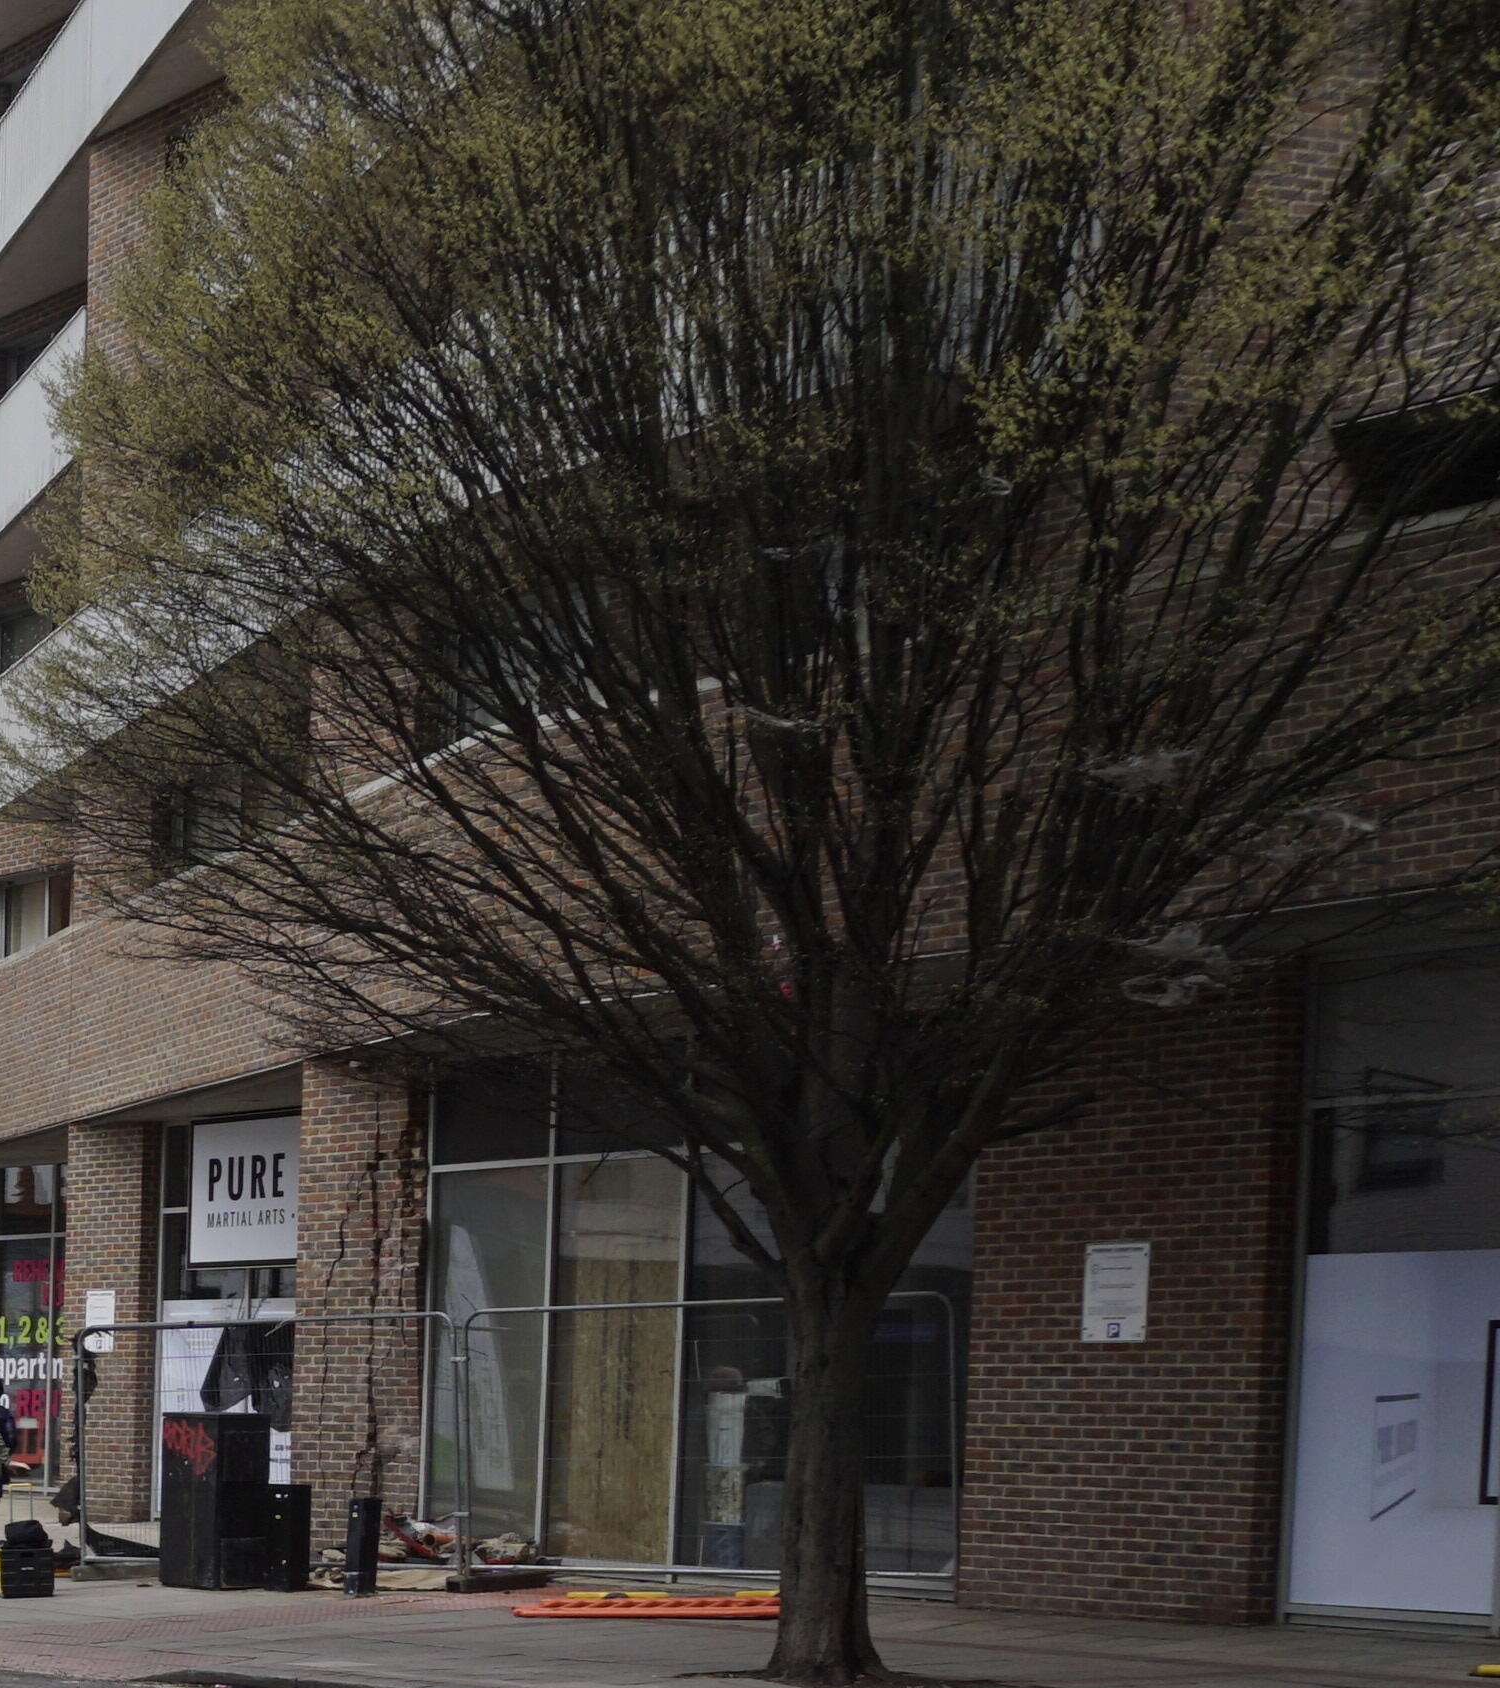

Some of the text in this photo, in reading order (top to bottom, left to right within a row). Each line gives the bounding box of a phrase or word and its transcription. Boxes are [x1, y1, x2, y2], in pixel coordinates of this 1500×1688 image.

[208, 1153, 286, 1202] PURE
[207, 1207, 286, 1228] MARTIAL ARTS
